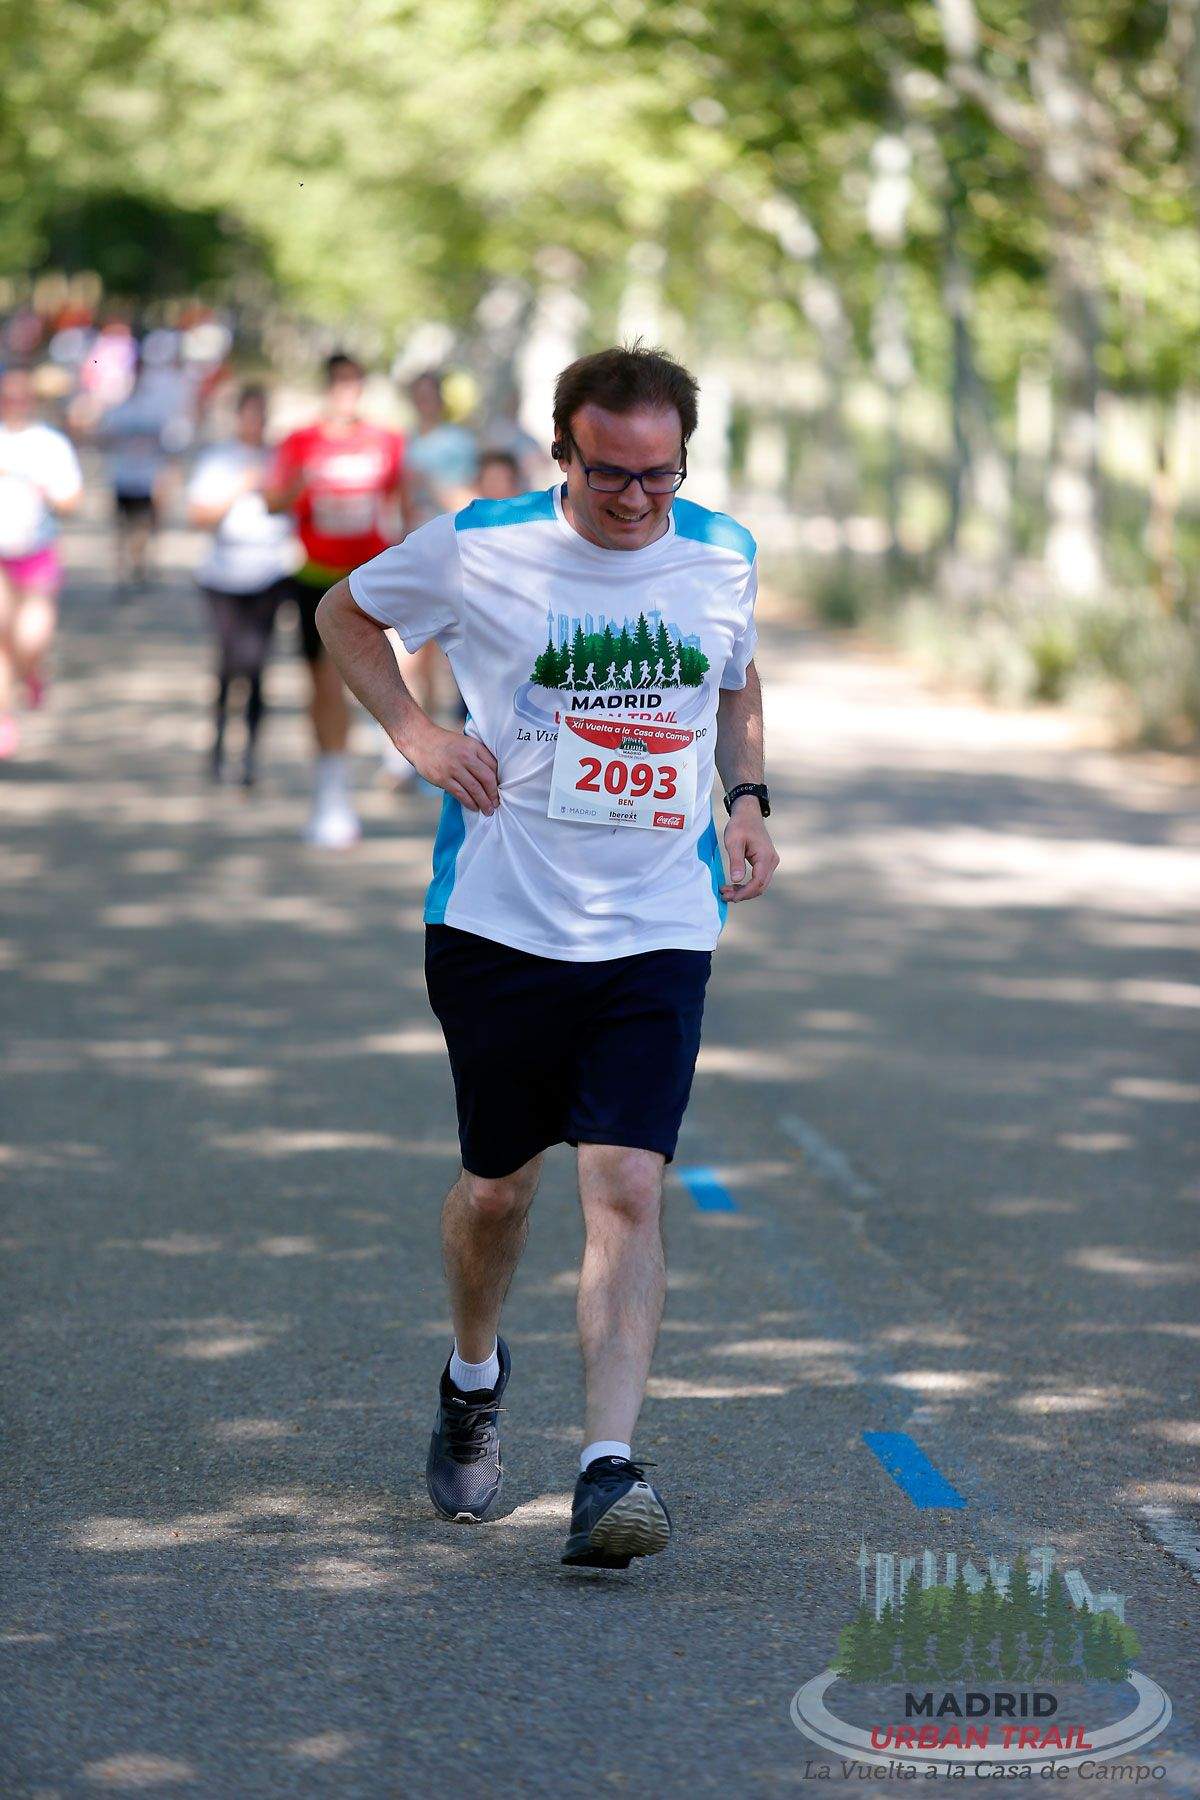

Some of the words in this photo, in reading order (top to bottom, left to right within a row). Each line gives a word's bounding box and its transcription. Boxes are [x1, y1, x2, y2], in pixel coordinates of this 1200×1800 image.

[571, 694, 662, 710] MADRID
[516, 729, 531, 740] La
[585, 723, 613, 733] Vuelta
[622, 726, 630, 735] la
[633, 728, 654, 737] Casa
[665, 732, 690, 742] Campo
[575, 757, 678, 800] 2093
[618, 798, 634, 806] BEN
[569, 807, 597, 816] MADRID
[609, 811, 637, 820] Iberext
